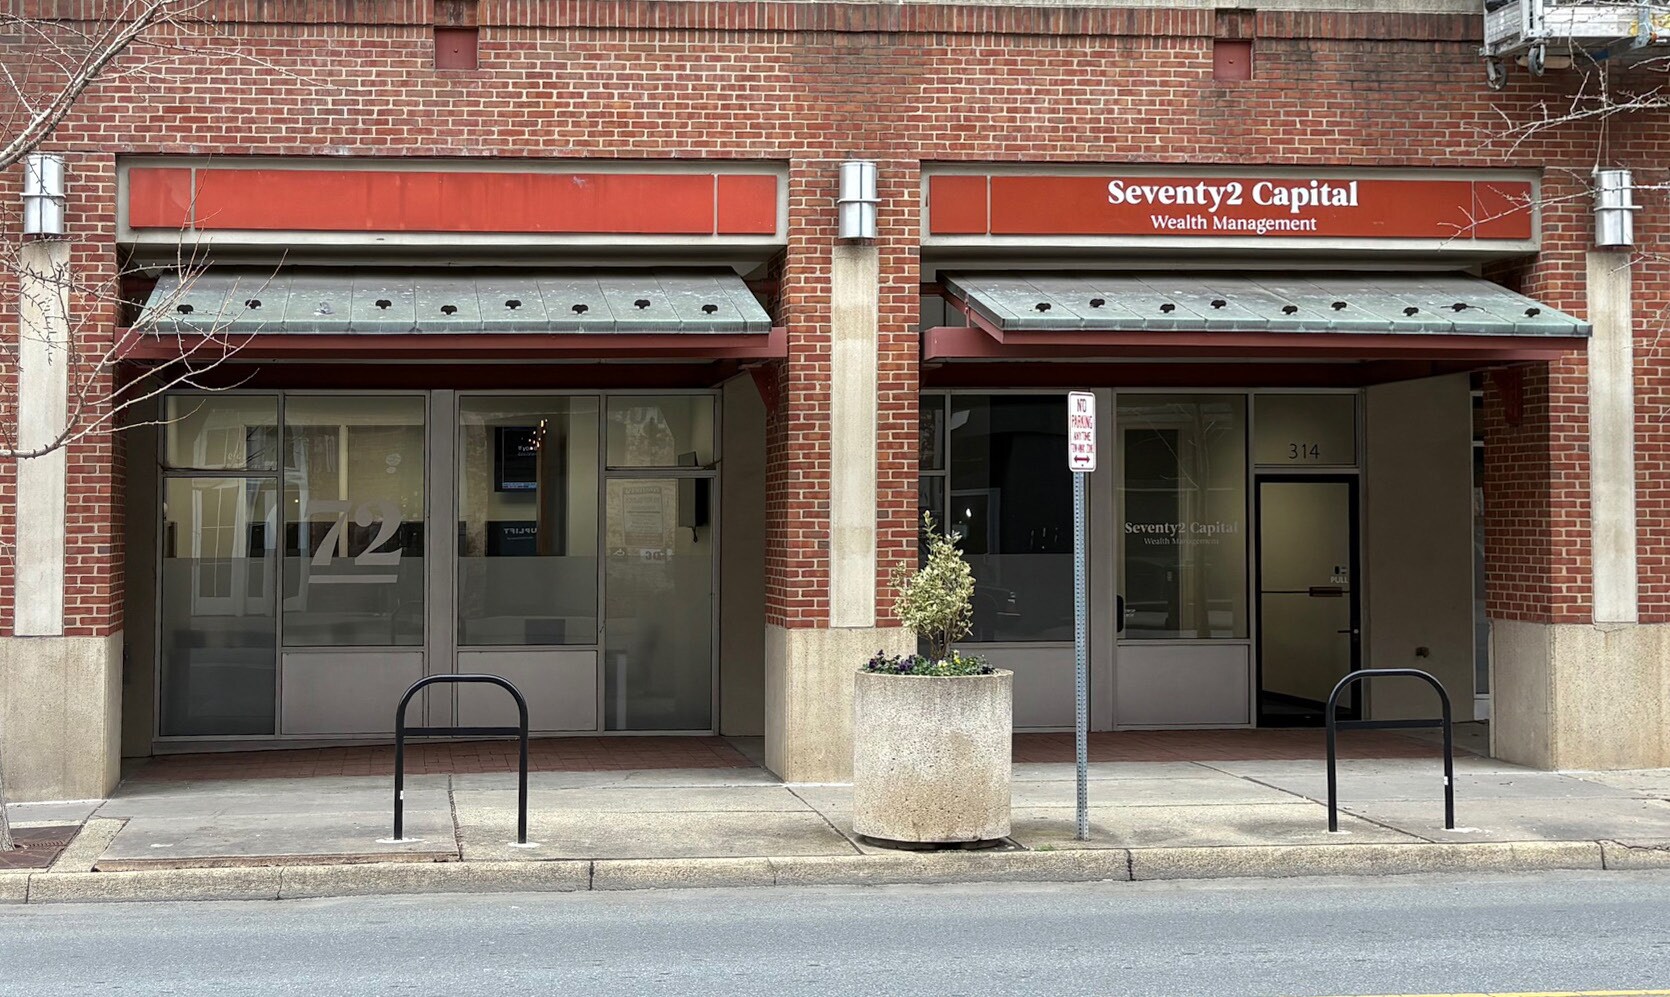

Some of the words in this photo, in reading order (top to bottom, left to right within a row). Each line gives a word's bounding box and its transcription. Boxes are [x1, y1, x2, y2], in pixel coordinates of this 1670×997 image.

[1107, 179, 1243, 213] Seventy2
[1252, 180, 1359, 214] Capital
[1150, 214, 1208, 230] Wealth
[1213, 215, 1317, 235] Management
[1076, 398, 1087, 412] NO
[1071, 414, 1093, 429] PARKING
[1287, 443, 1321, 460] 314
[308, 499, 404, 566] 72
[1124, 521, 1186, 537] Seventy2
[1190, 521, 1239, 537] Capital
[1143, 537, 1170, 545] Wealth
[1330, 576, 1349, 584] PULL
